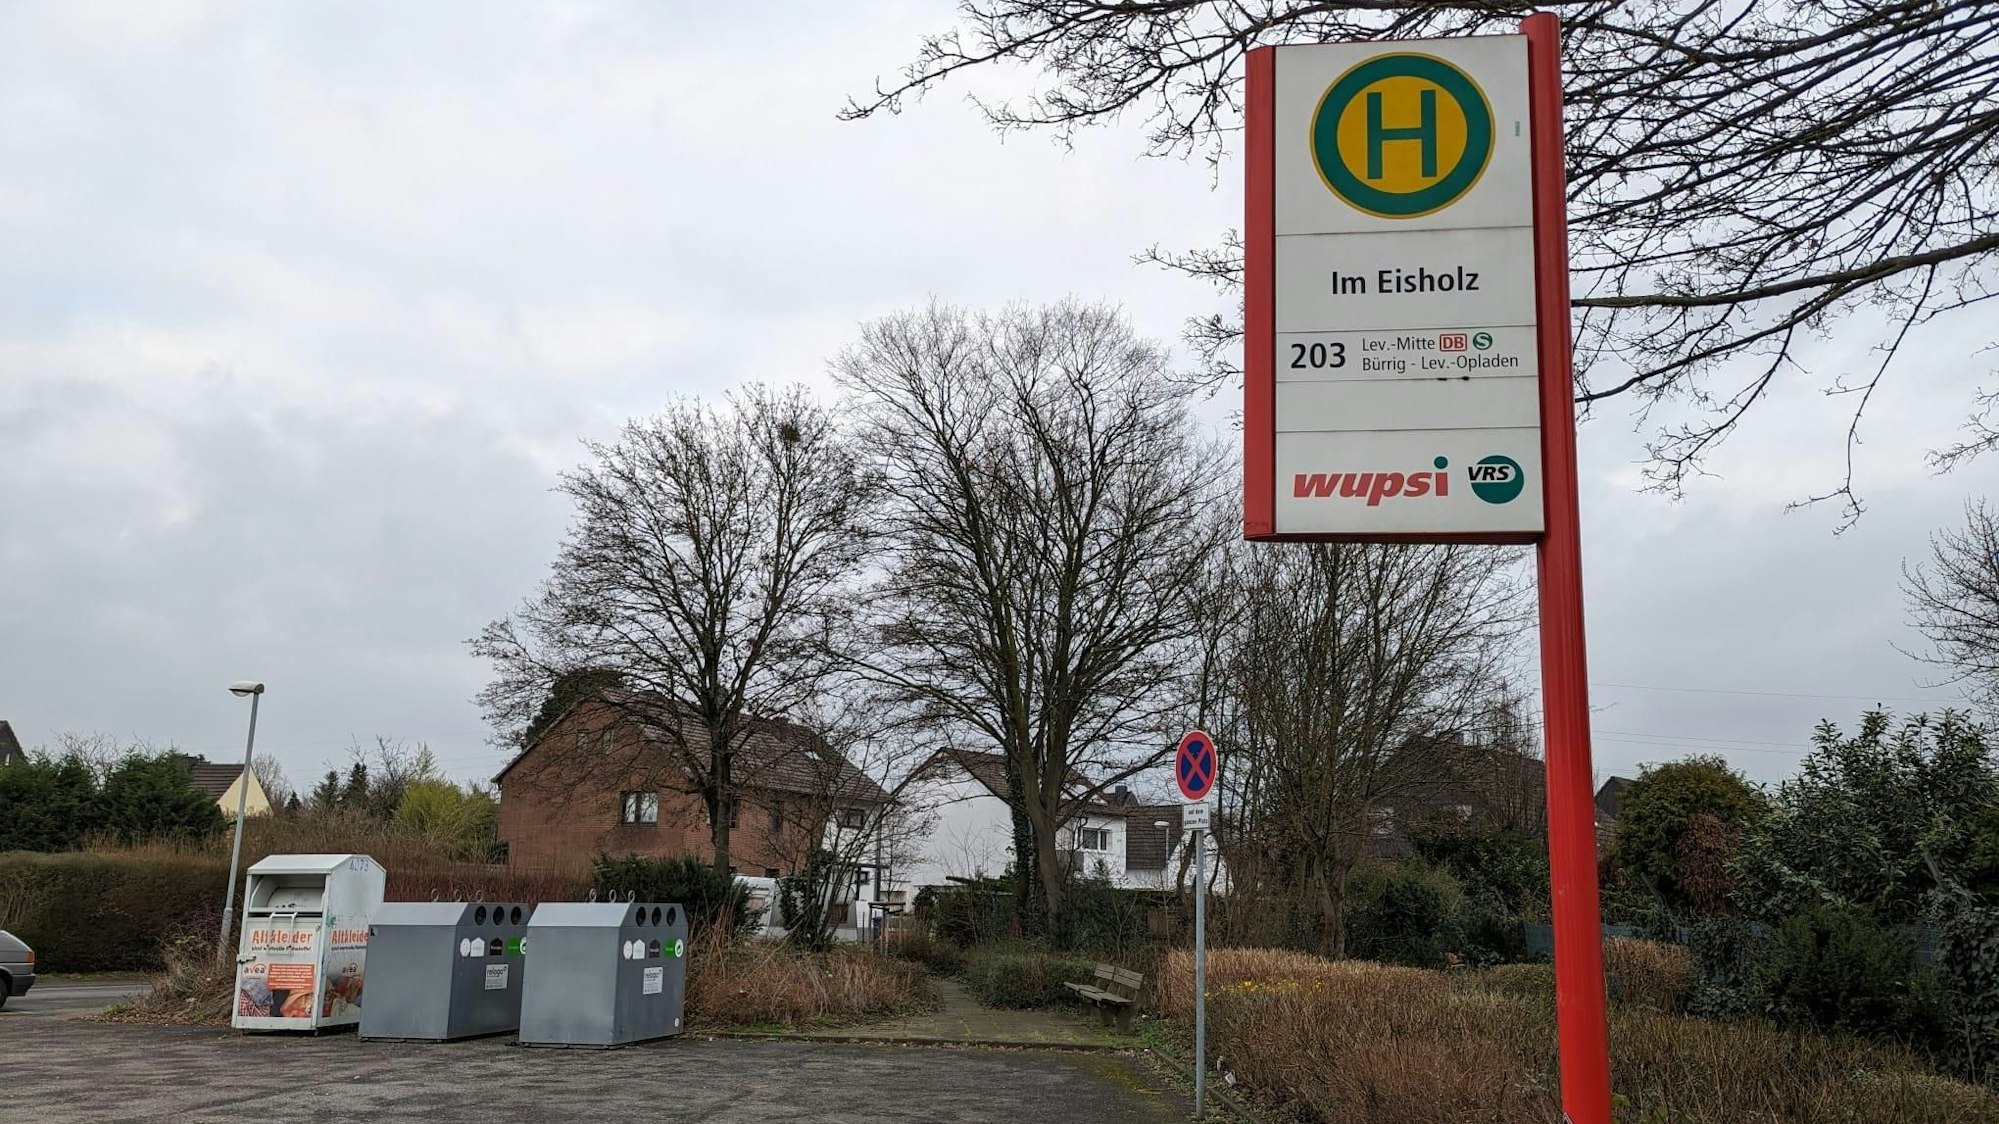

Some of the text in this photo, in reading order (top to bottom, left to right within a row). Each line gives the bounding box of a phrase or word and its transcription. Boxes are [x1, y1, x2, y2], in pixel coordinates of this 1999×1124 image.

[1366, 89, 1438, 180] H
[1331, 265, 1479, 295] Im Eisholz
[1362, 336, 1435, 351] Lev.-Mitte
[1442, 336, 1465, 350] DB
[1290, 342, 1347, 369] 203
[1362, 357, 1406, 373] Bürrig
[1421, 354, 1519, 371] Lev.-Opladen
[1293, 456, 1511, 506] wupsi VRS
[252, 929, 313, 945] Altkleder
[331, 930, 369, 944] Altkleide
[244, 966, 266, 974] avea
